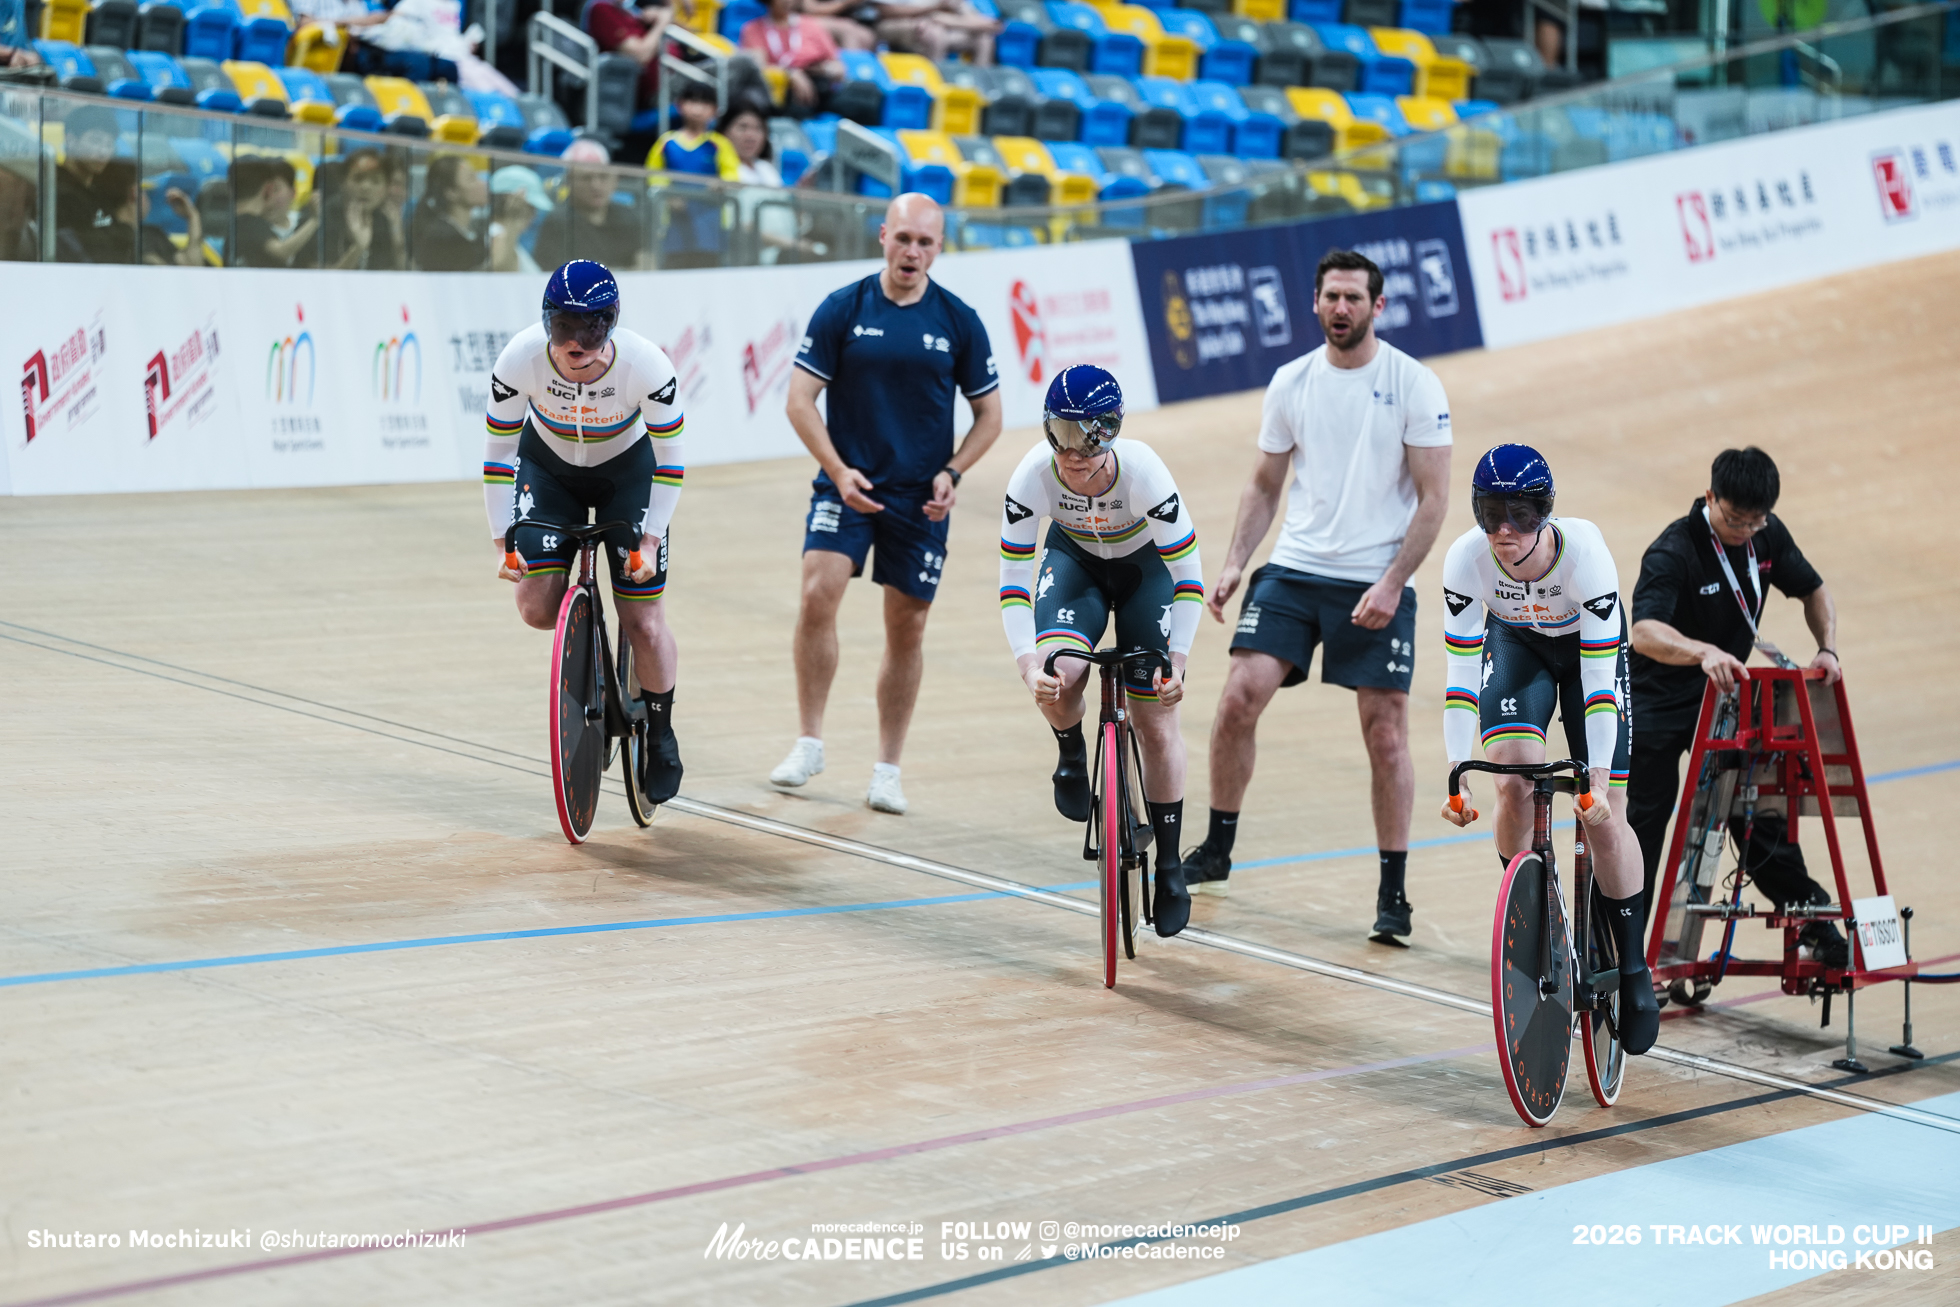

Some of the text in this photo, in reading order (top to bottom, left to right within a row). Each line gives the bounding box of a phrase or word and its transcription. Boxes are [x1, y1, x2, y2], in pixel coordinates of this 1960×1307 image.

[552, 388, 576, 401] UCI
[1064, 502, 1089, 513] UCI
[1500, 590, 1526, 601] UCI
